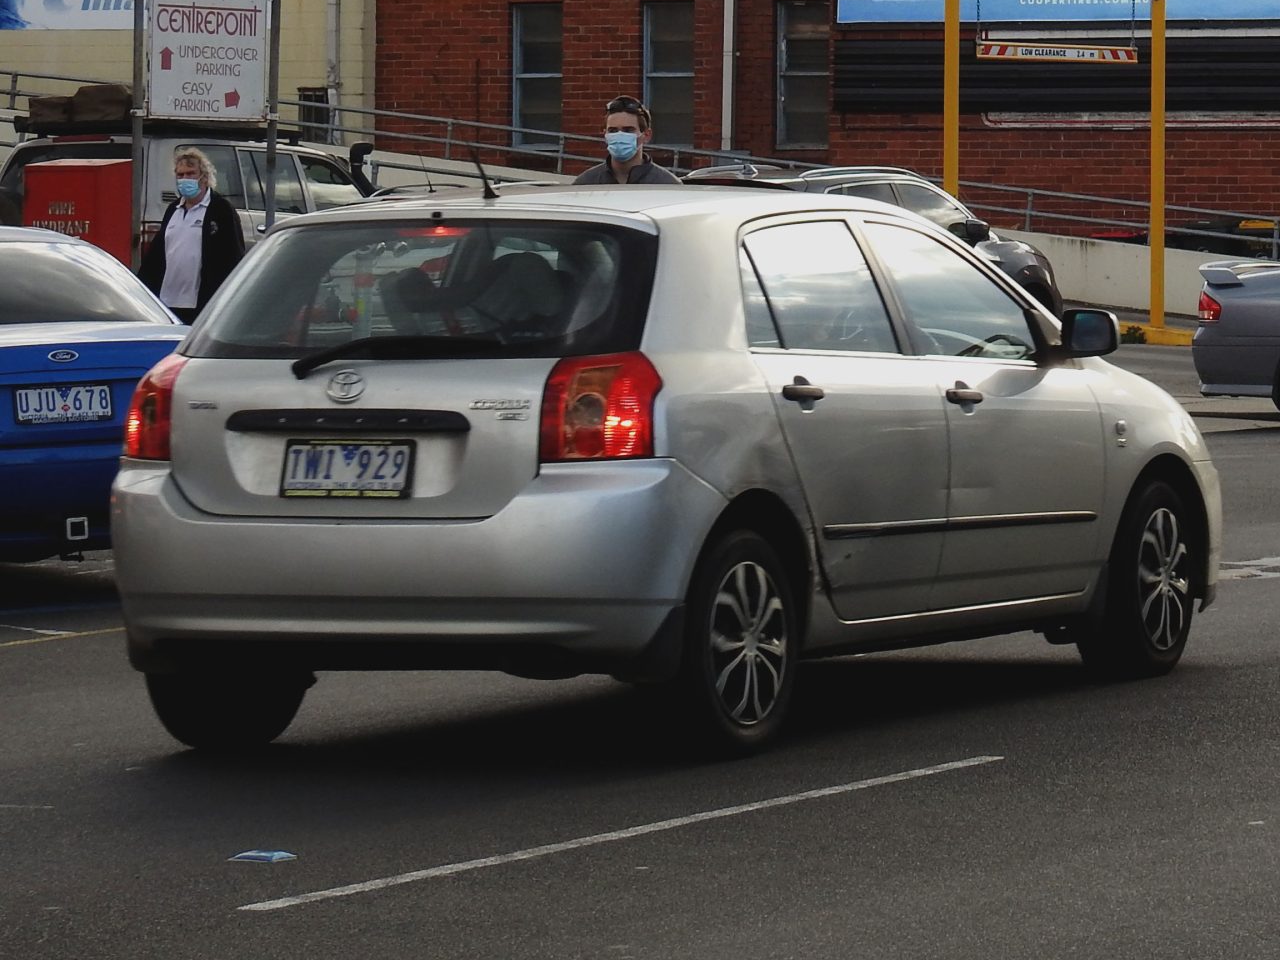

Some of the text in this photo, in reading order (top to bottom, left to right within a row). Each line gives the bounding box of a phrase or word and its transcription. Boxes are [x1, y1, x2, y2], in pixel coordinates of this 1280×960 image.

[157, 2, 262, 37] CENTREPOINT
[178, 45, 258, 61] UNDERCOVER
[1021, 48, 1034, 57] LOW
[1034, 49, 1067, 58] CLEARANCE
[1076, 50, 1085, 58] 2.4
[195, 63, 241, 77] PARKING
[182, 81, 213, 95] EASY
[173, 98, 220, 113] PARKING
[19, 389, 109, 413] UJU 678
[291, 449, 405, 480] TWI 929
